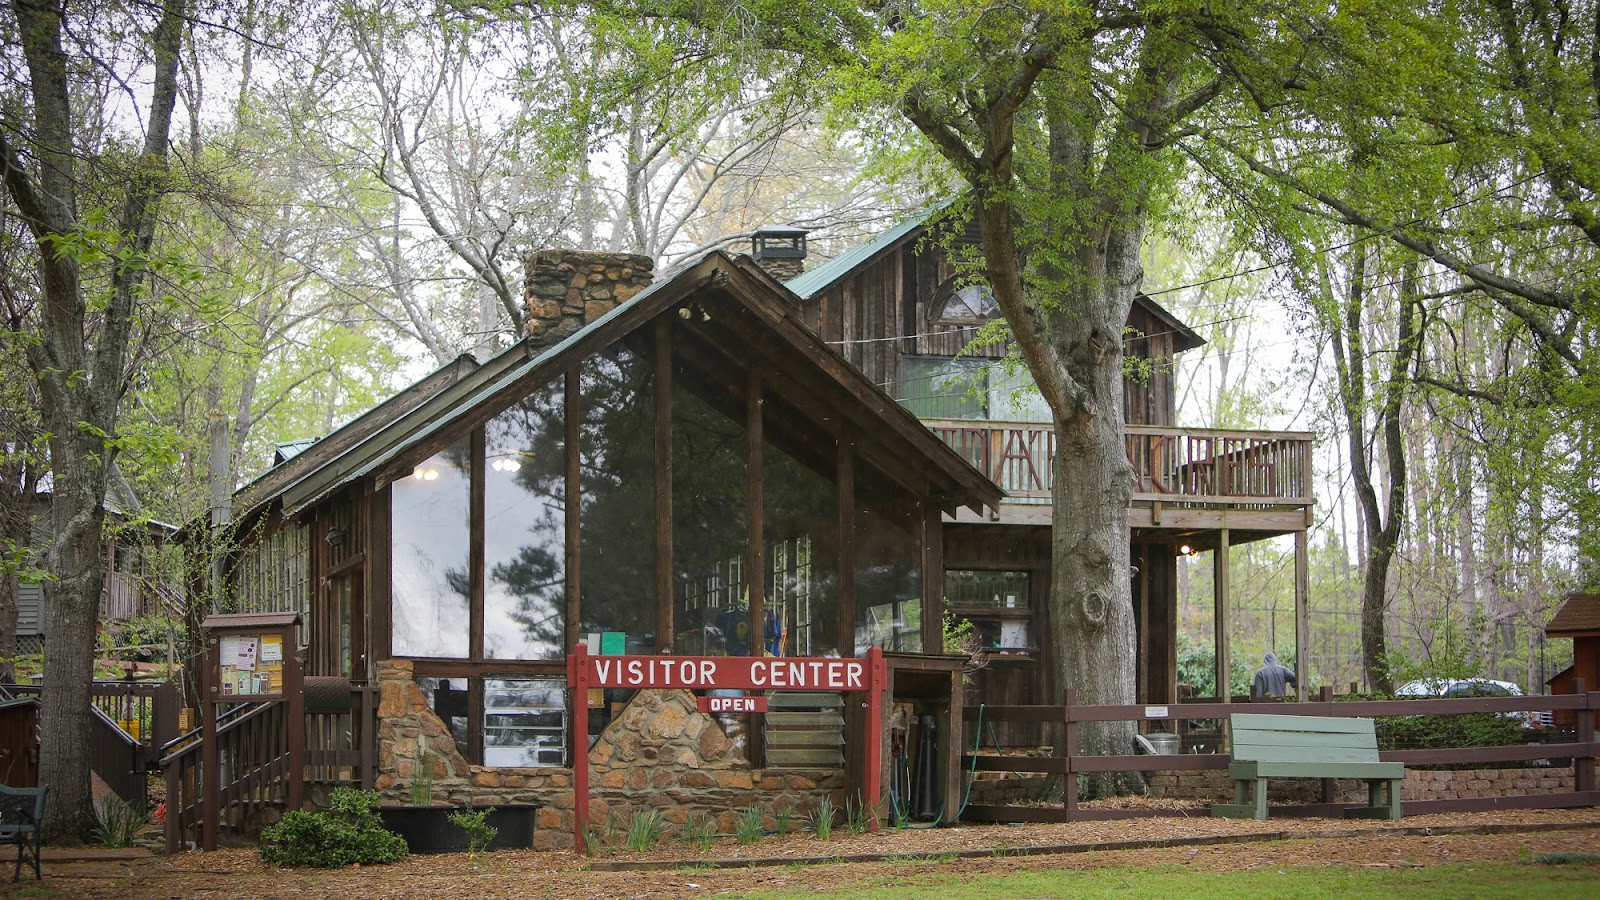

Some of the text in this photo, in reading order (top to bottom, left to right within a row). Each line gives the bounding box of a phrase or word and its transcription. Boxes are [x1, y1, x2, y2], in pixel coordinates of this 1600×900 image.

[595, 660, 863, 687] VISITOR CENTER
[710, 698, 755, 711] OPEN
